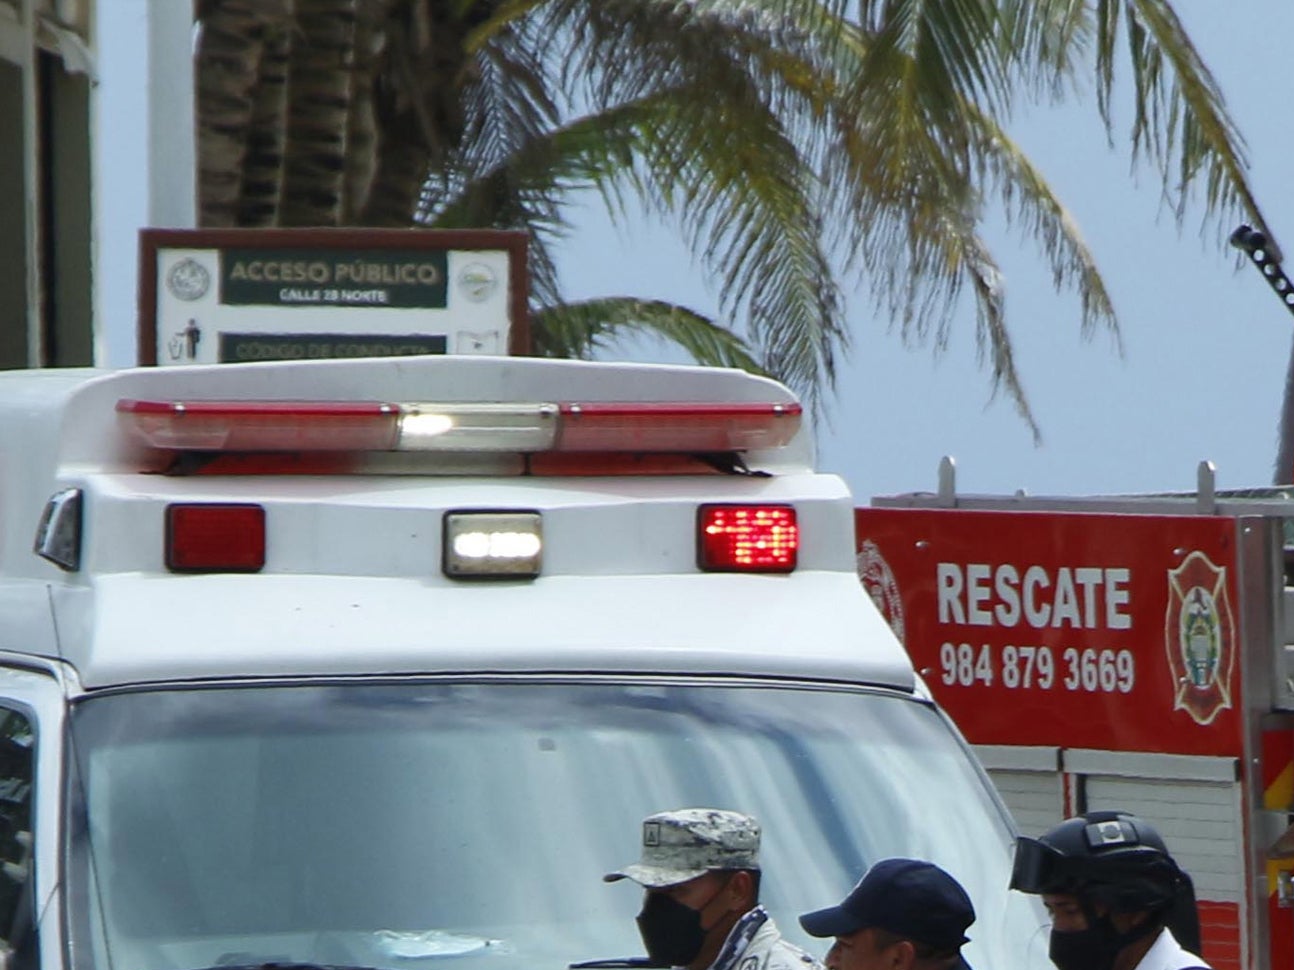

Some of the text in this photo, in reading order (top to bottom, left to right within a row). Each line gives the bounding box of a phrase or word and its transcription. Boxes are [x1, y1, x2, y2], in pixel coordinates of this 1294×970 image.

[231, 259, 438, 284] ACCESO PÚBLICO
[279, 288, 320, 301] CALLE
[342, 289, 387, 302] NORTE
[937, 562, 1132, 630] RESCATE
[940, 643, 1135, 693] 984 879 3669
